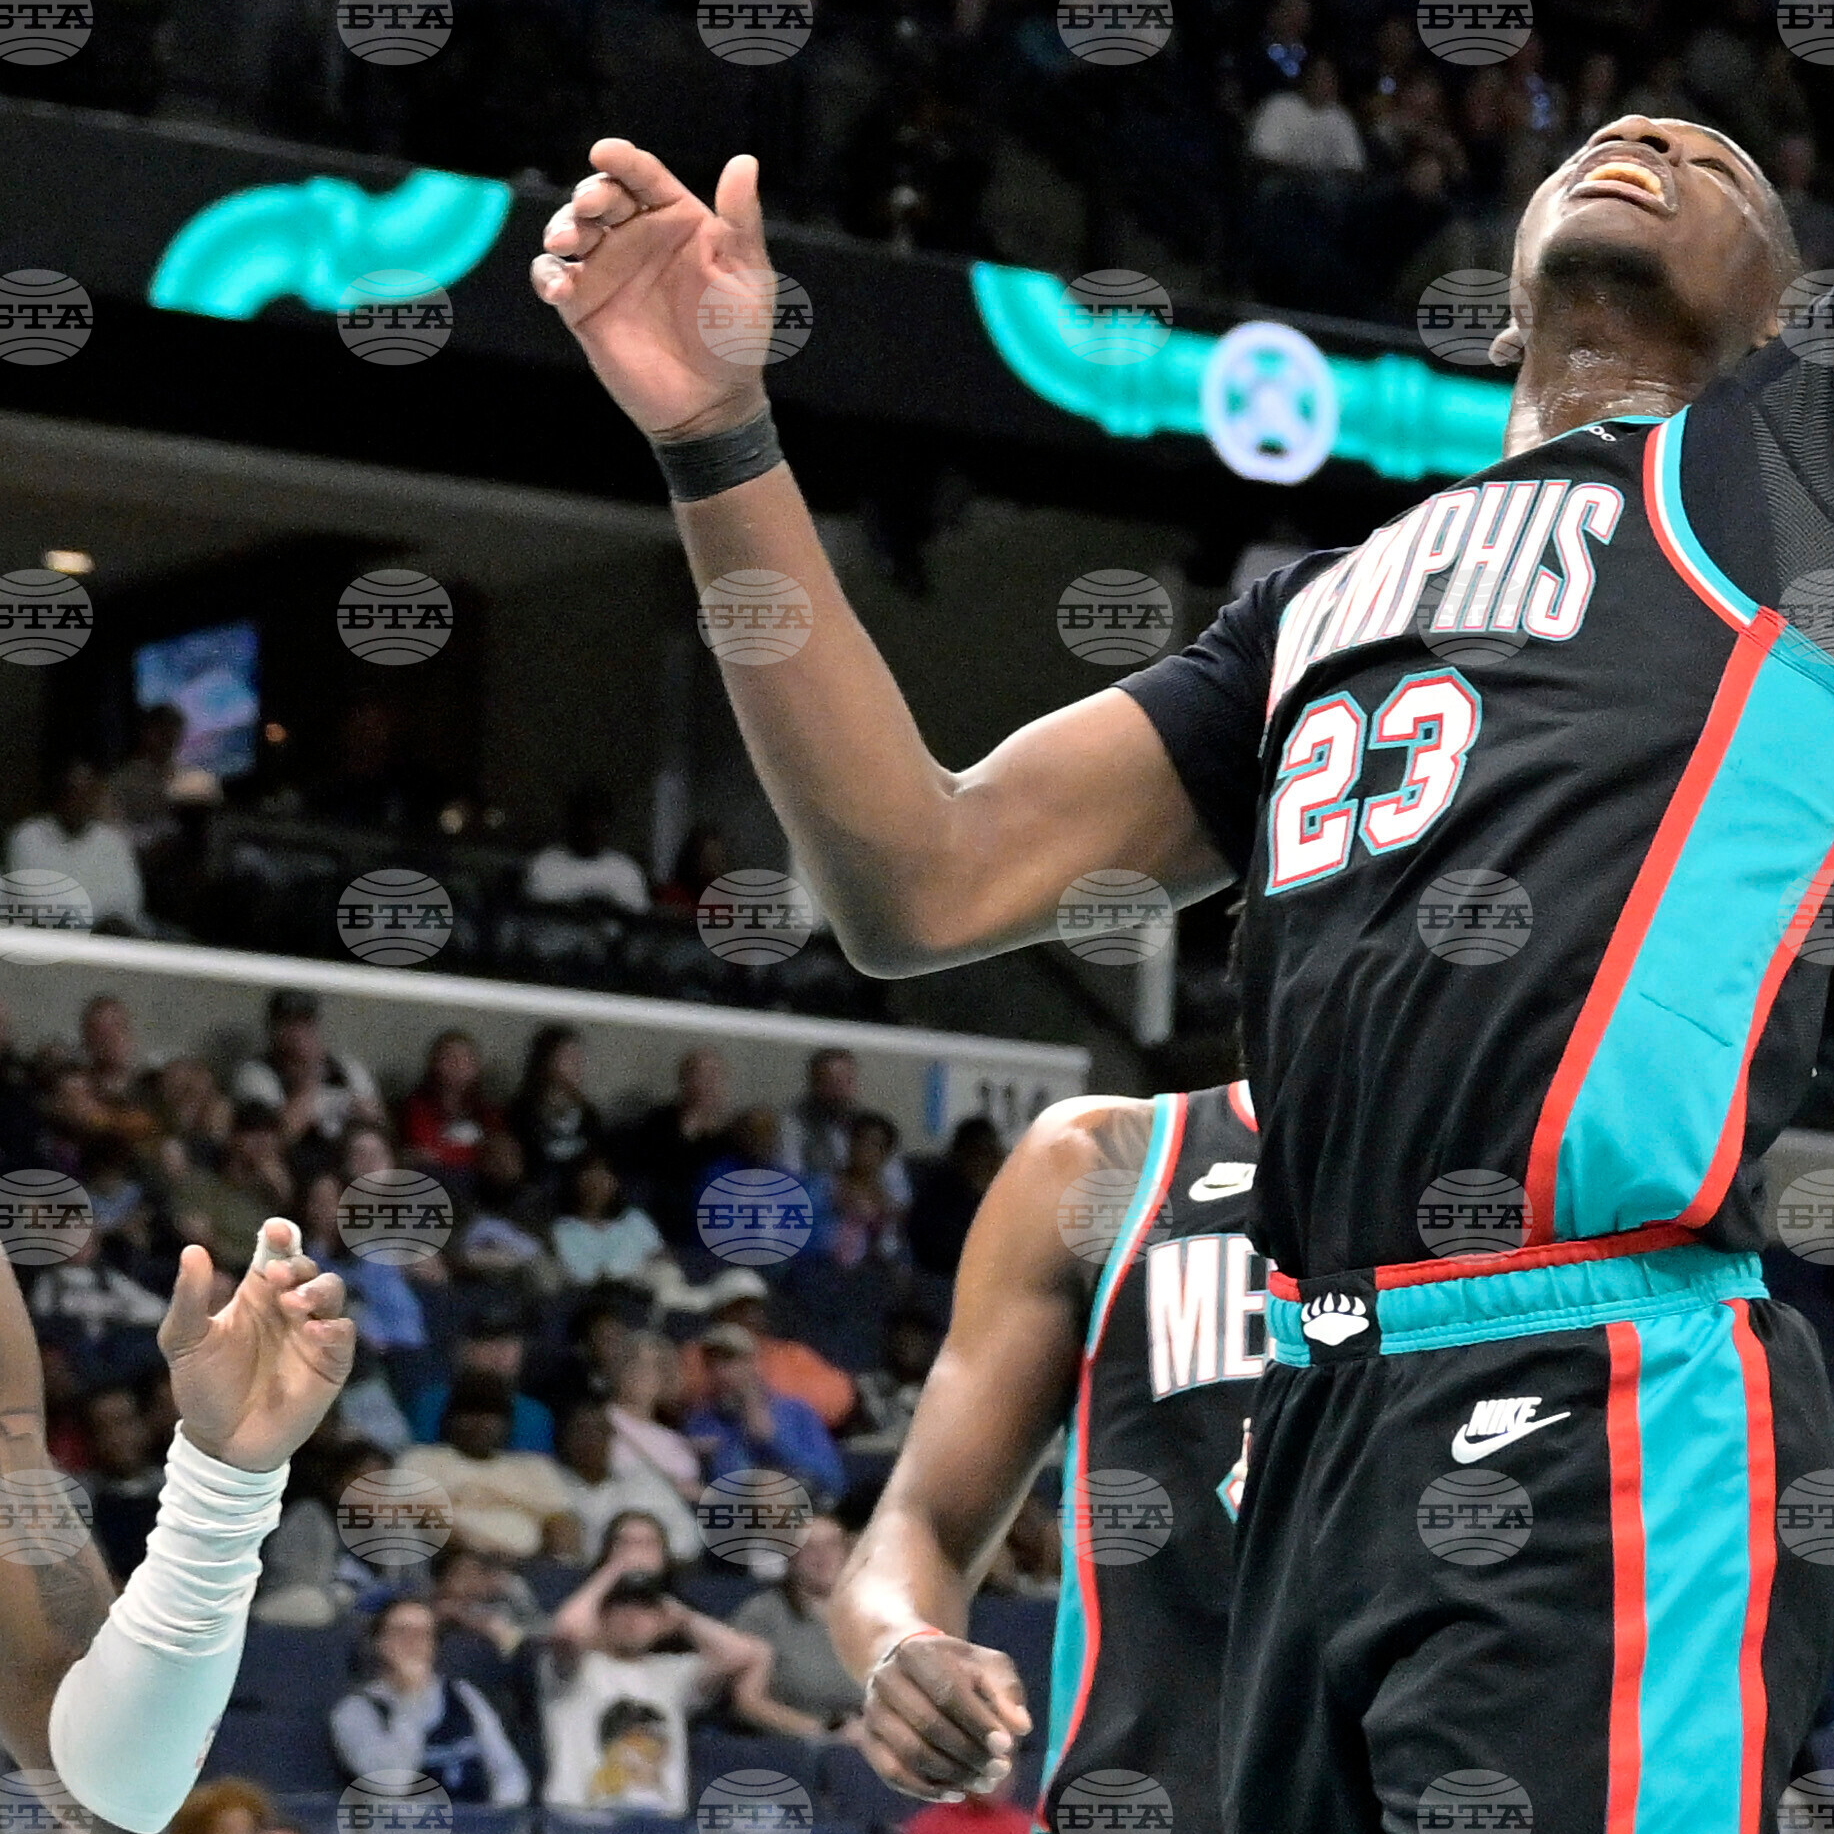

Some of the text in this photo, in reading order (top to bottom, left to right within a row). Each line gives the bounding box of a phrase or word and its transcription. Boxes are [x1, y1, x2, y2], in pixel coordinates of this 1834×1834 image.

[1264, 666, 1483, 897] 23
[1147, 1233, 1276, 1403] ME
[1466, 1396, 1542, 1437] NIKE
